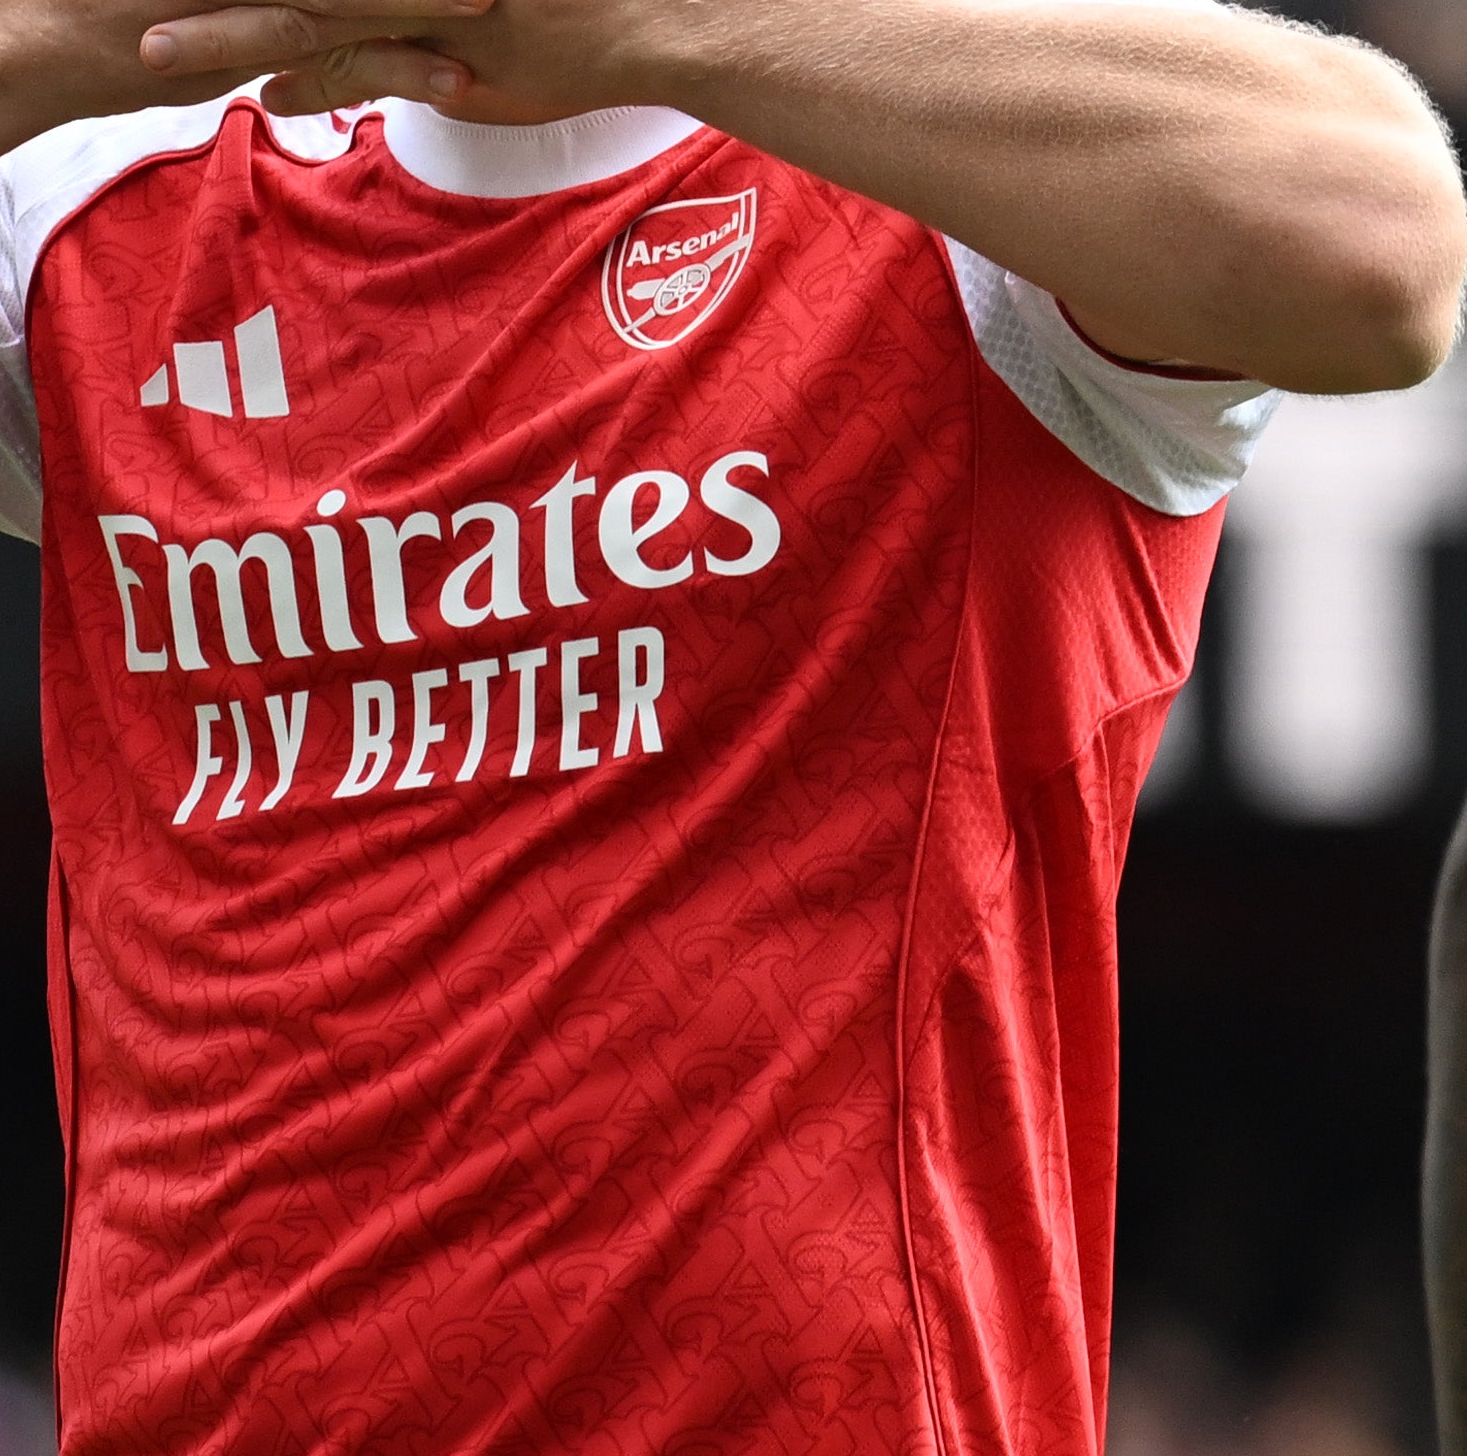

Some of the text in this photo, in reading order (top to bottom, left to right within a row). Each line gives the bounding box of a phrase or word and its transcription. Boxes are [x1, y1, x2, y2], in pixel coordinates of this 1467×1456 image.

[626, 212, 740, 267] Arsenal
[98, 450, 781, 673] Emirates
[172, 626, 666, 825] FLY BETTER
